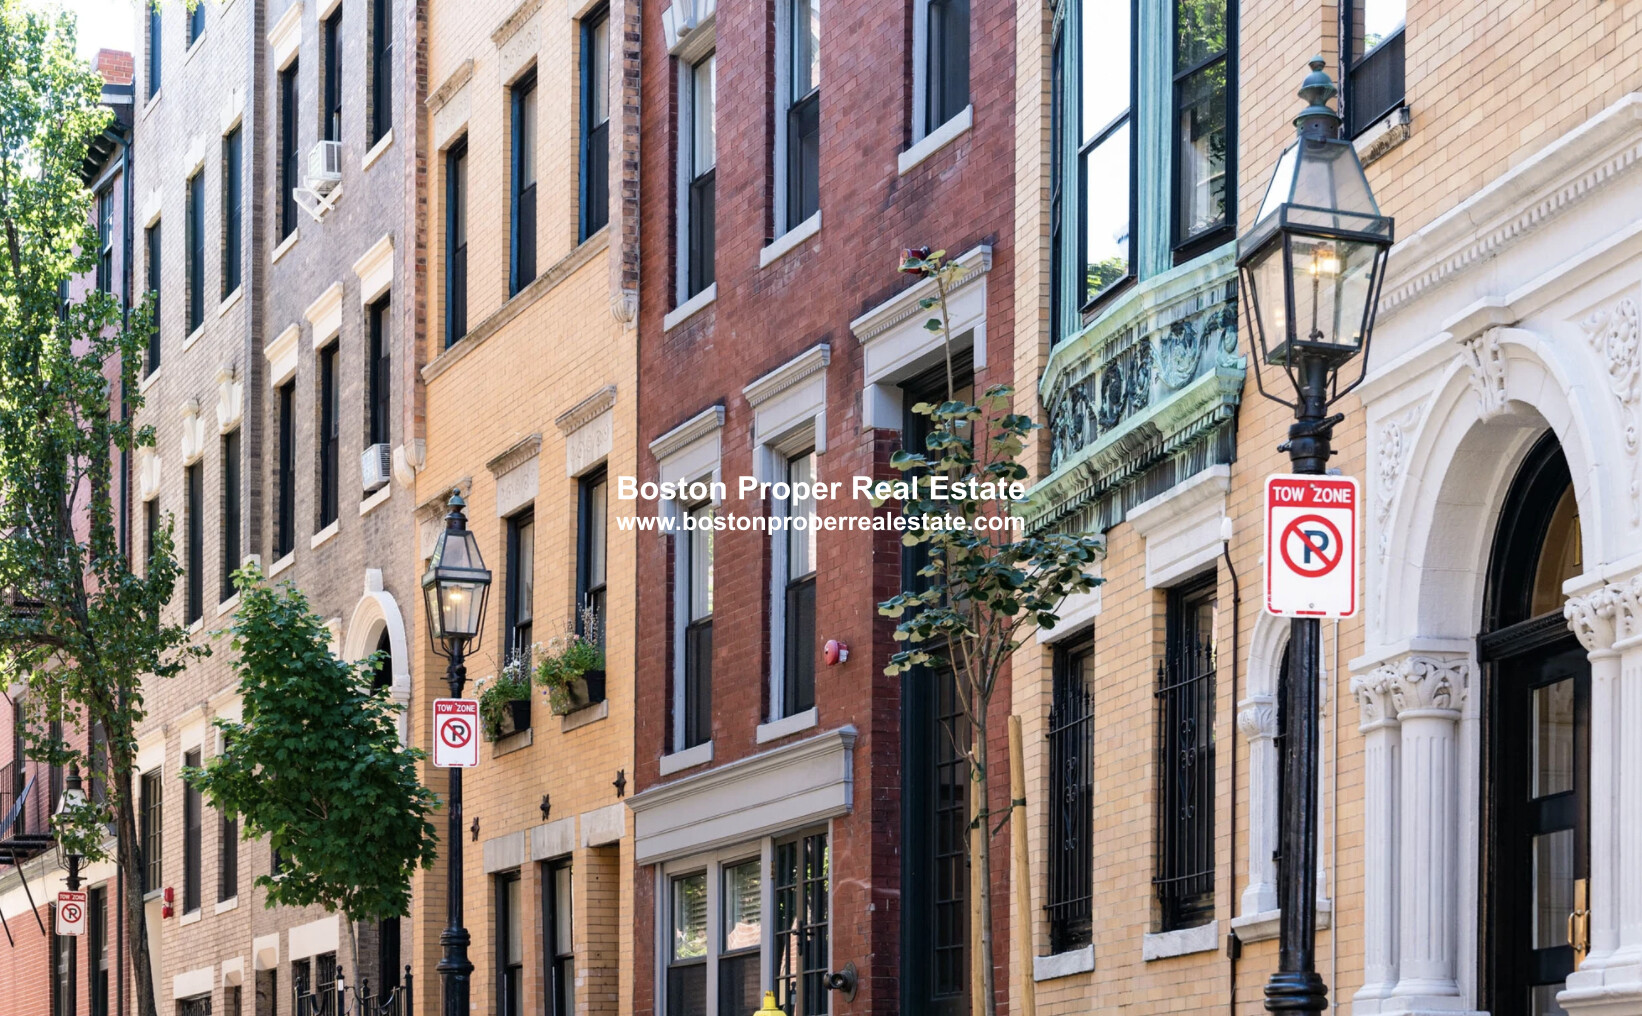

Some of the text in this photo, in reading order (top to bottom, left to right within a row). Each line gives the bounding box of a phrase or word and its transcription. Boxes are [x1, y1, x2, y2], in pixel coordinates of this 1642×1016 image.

[1272, 486, 1352, 503] TOW ZONE
[437, 704, 476, 712] TOW ZONE
